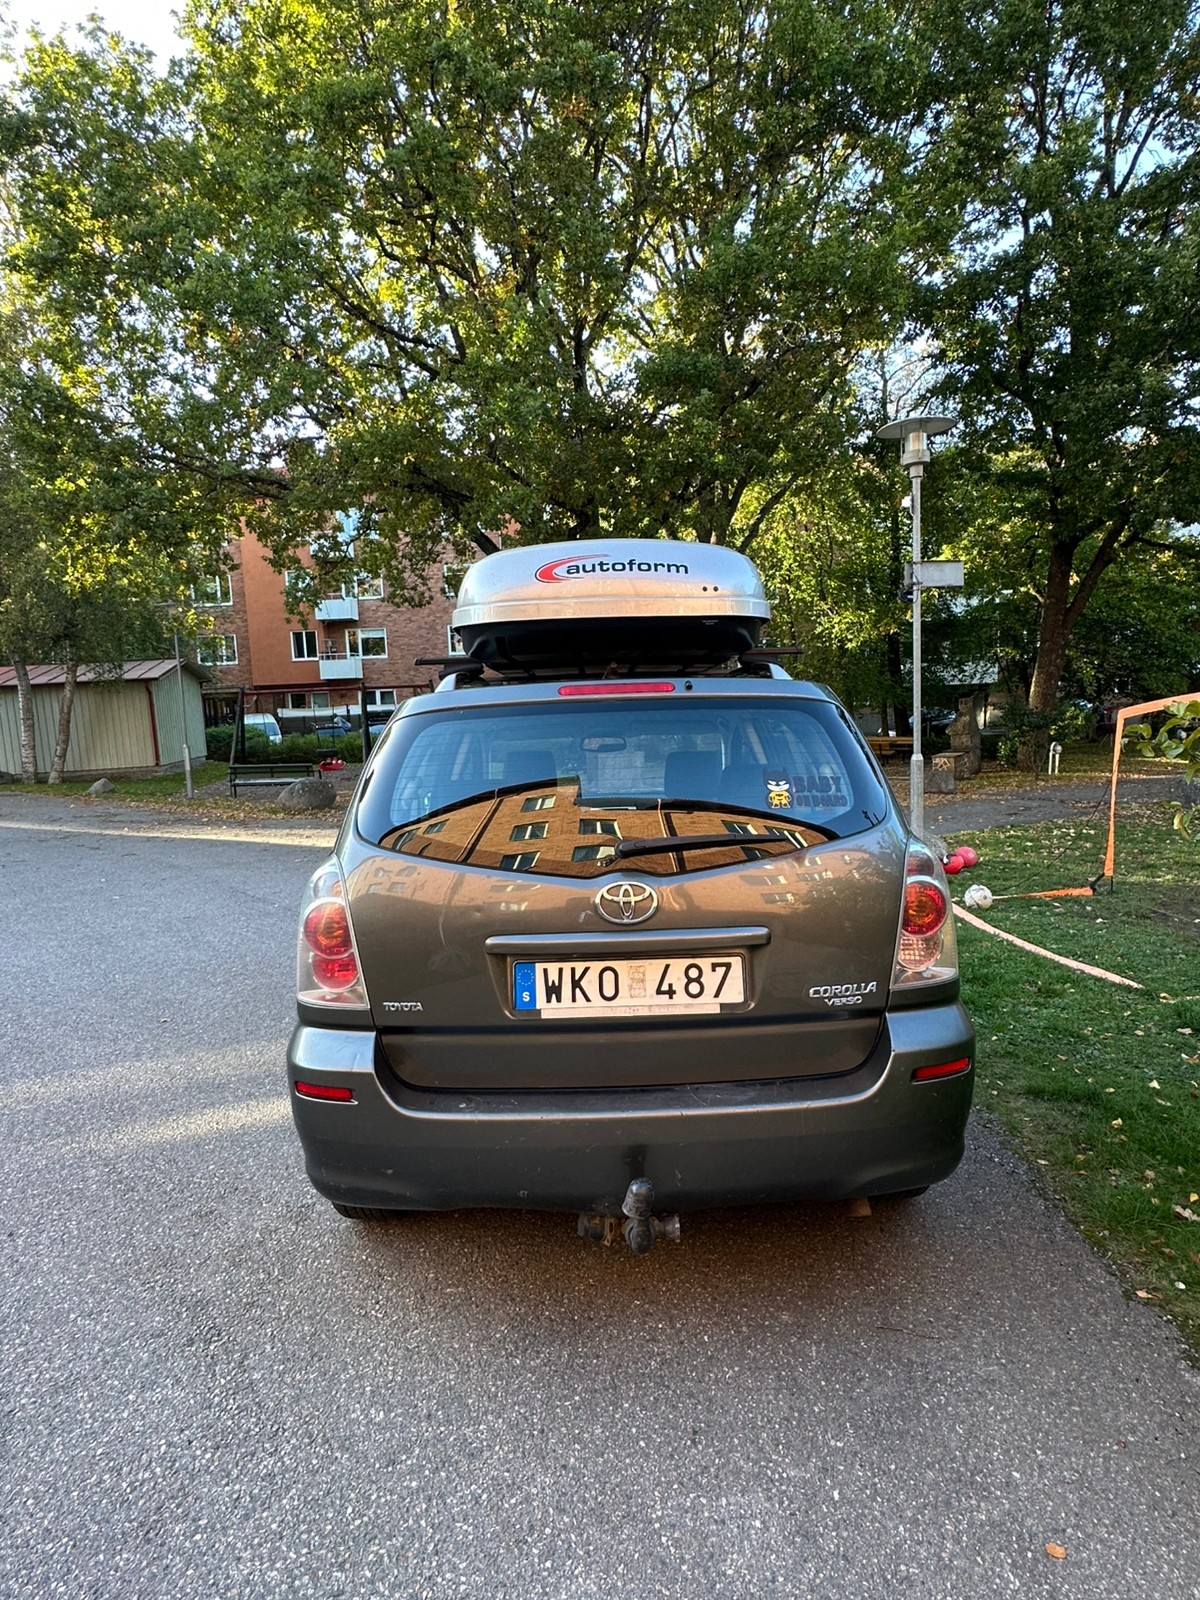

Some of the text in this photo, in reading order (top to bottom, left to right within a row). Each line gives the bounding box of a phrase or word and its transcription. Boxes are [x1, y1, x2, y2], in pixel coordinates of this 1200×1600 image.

[566, 559, 689, 575] autoform
[792, 776, 842, 793] BABY
[542, 962, 732, 1004] WKO 487
[809, 981, 877, 998] COROLLA
[522, 991, 531, 1002] S
[824, 995, 863, 1006] VERSO
[382, 1001, 424, 1011] TOYOTA
